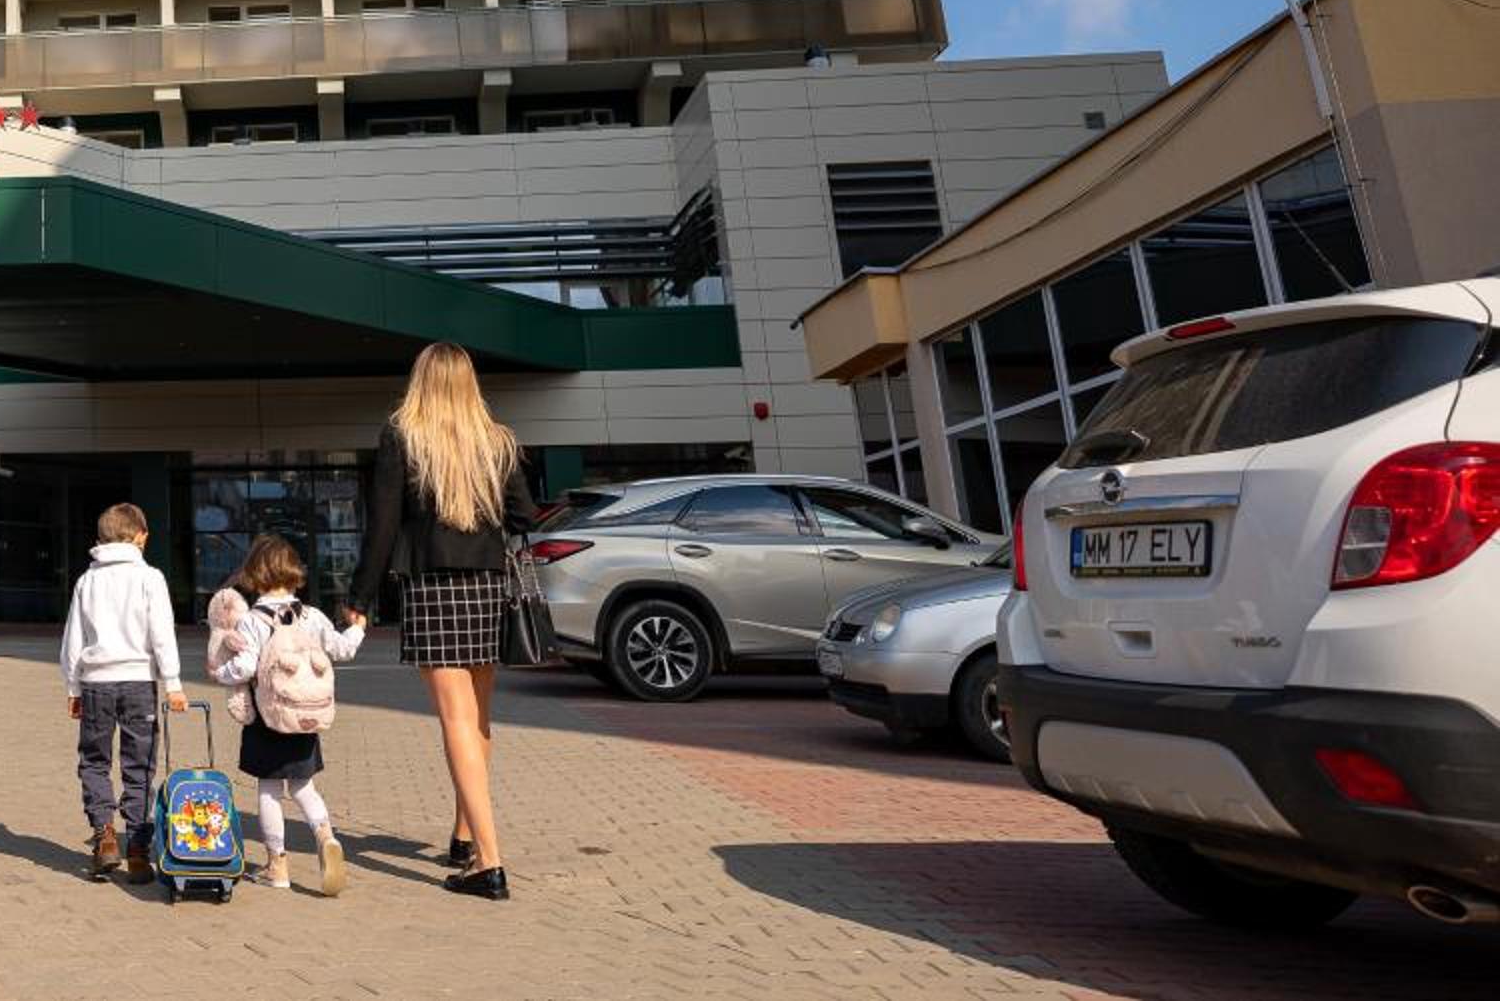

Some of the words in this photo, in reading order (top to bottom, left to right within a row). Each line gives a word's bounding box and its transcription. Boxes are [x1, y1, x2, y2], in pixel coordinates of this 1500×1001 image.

[1083, 533, 1112, 564] MM
[1119, 530, 1138, 562] 17
[1151, 527, 1201, 563] ELY
